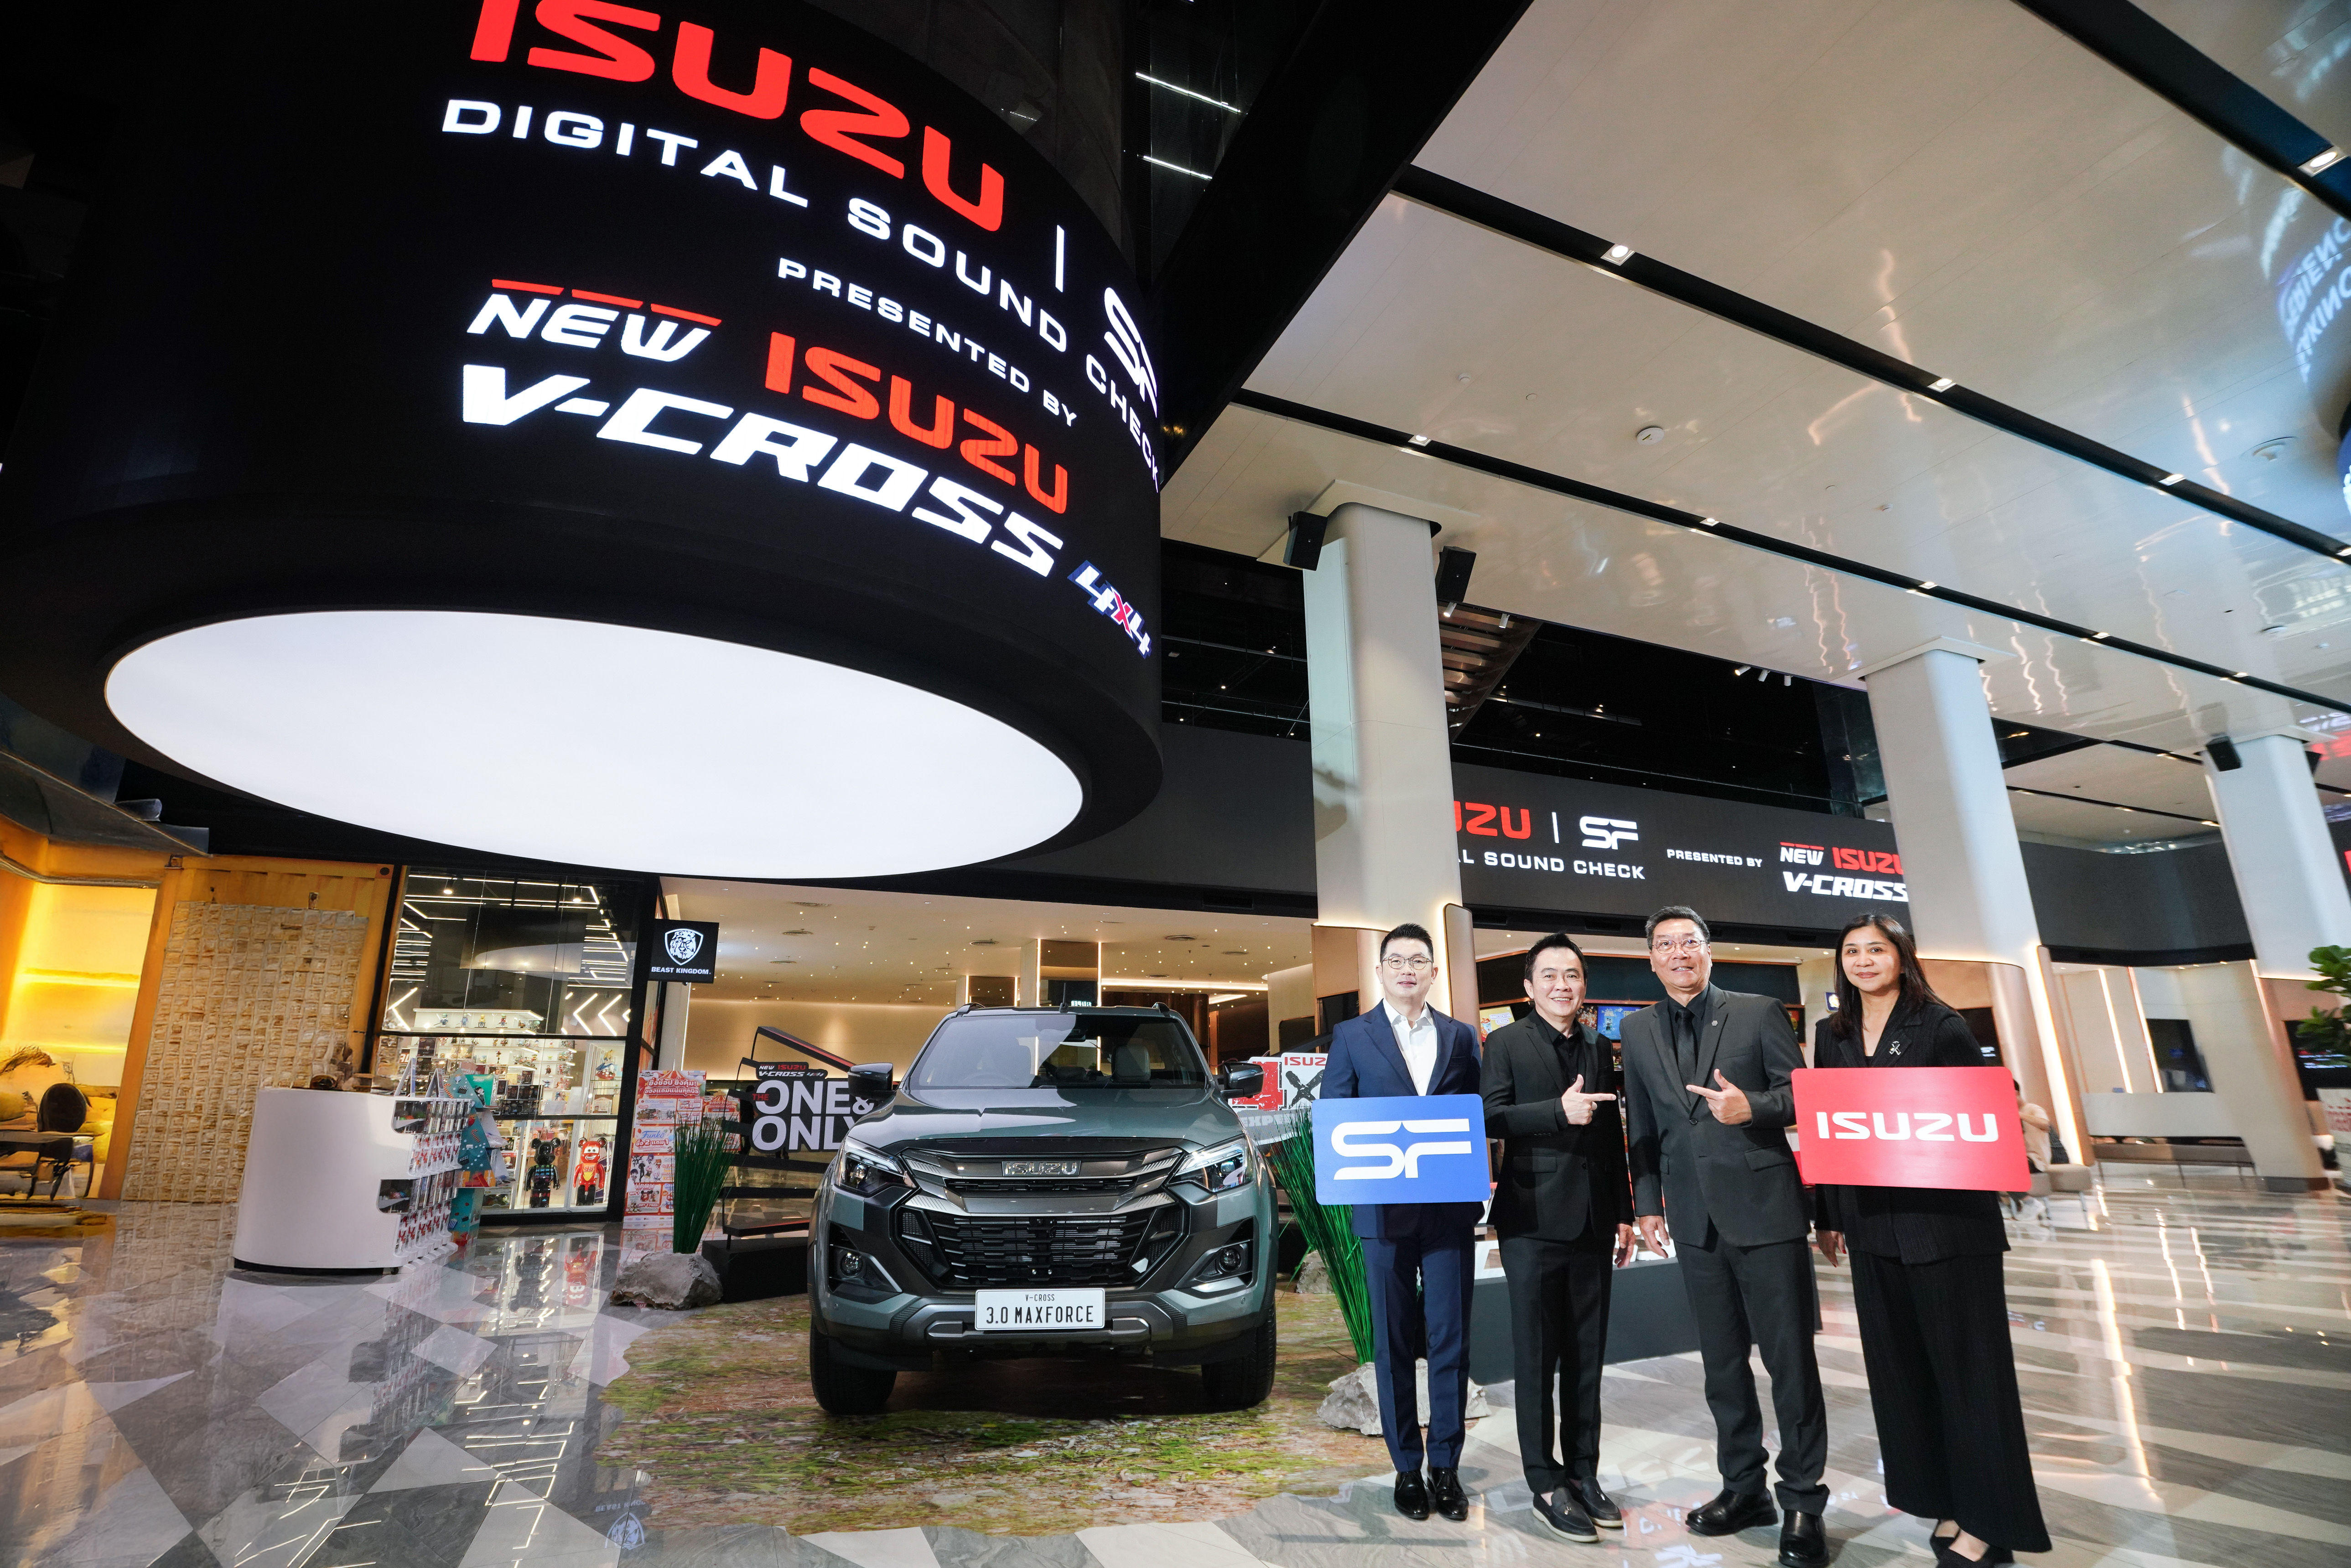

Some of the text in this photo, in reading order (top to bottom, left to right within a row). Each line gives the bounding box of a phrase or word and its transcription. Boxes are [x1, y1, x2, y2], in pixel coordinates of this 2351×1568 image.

[470, 0, 1004, 231] ISUZU
[442, 100, 808, 207] DIGITAL
[848, 198, 1066, 352] SOUND
[778, 258, 1077, 427] PRESENTED BY
[467, 292, 1068, 513] NEW ISUZU
[463, 364, 1063, 577] V-CROSS
[1579, 816, 1639, 850] SF
[1484, 851, 1564, 872] SOUND
[1573, 860, 1645, 880] CHECK
[1666, 849, 1763, 868] PRESENTED BY
[1780, 846, 1824, 866] NEW
[1816, 1112, 1998, 1142] ISUZU
[1331, 1118, 1472, 1180] SF
[1005, 1162, 1077, 1175] ISUZU
[986, 1305, 1094, 1324] 3.0 MAXFORCE
